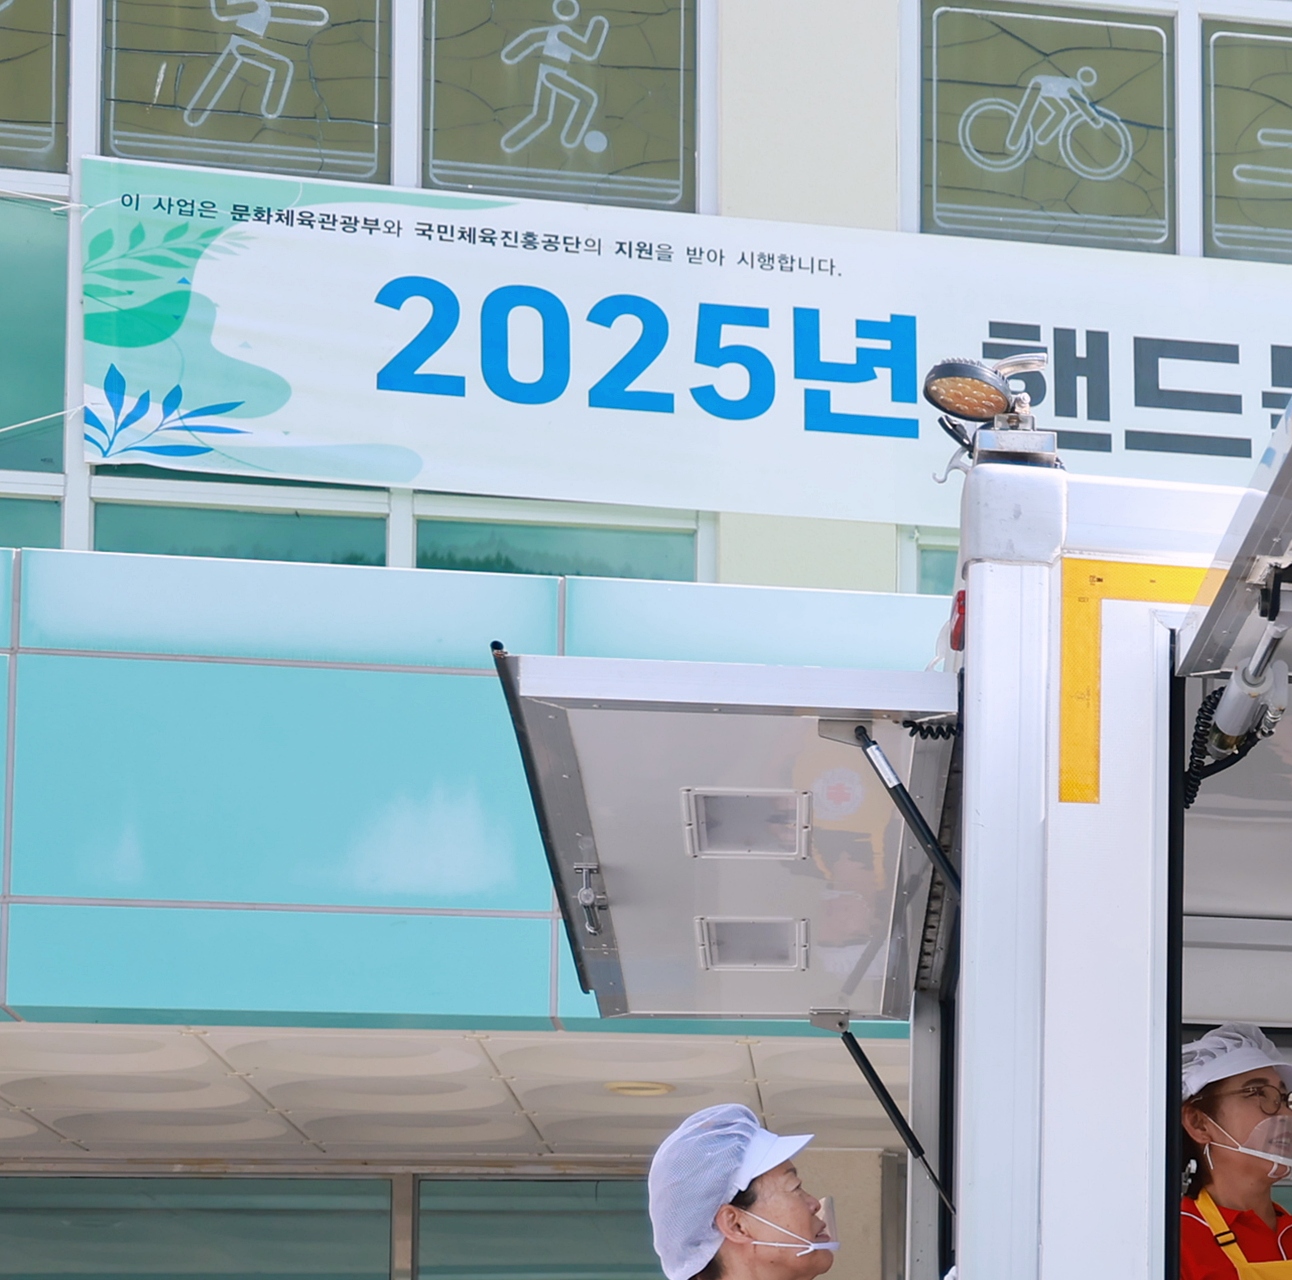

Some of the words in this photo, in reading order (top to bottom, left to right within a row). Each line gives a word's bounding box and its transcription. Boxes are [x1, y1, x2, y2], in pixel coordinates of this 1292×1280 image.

[120, 193, 140, 211] 이
[152, 196, 219, 220] 사업은
[229, 202, 403, 239] 문화체육관광부와
[414, 221, 602, 256] 국민체육진흥공단의
[614, 239, 675, 262] 지원을
[685, 246, 726, 266] 받아
[736, 251, 843, 277] 시행합니다.
[373, 275, 920, 439] 2025년
